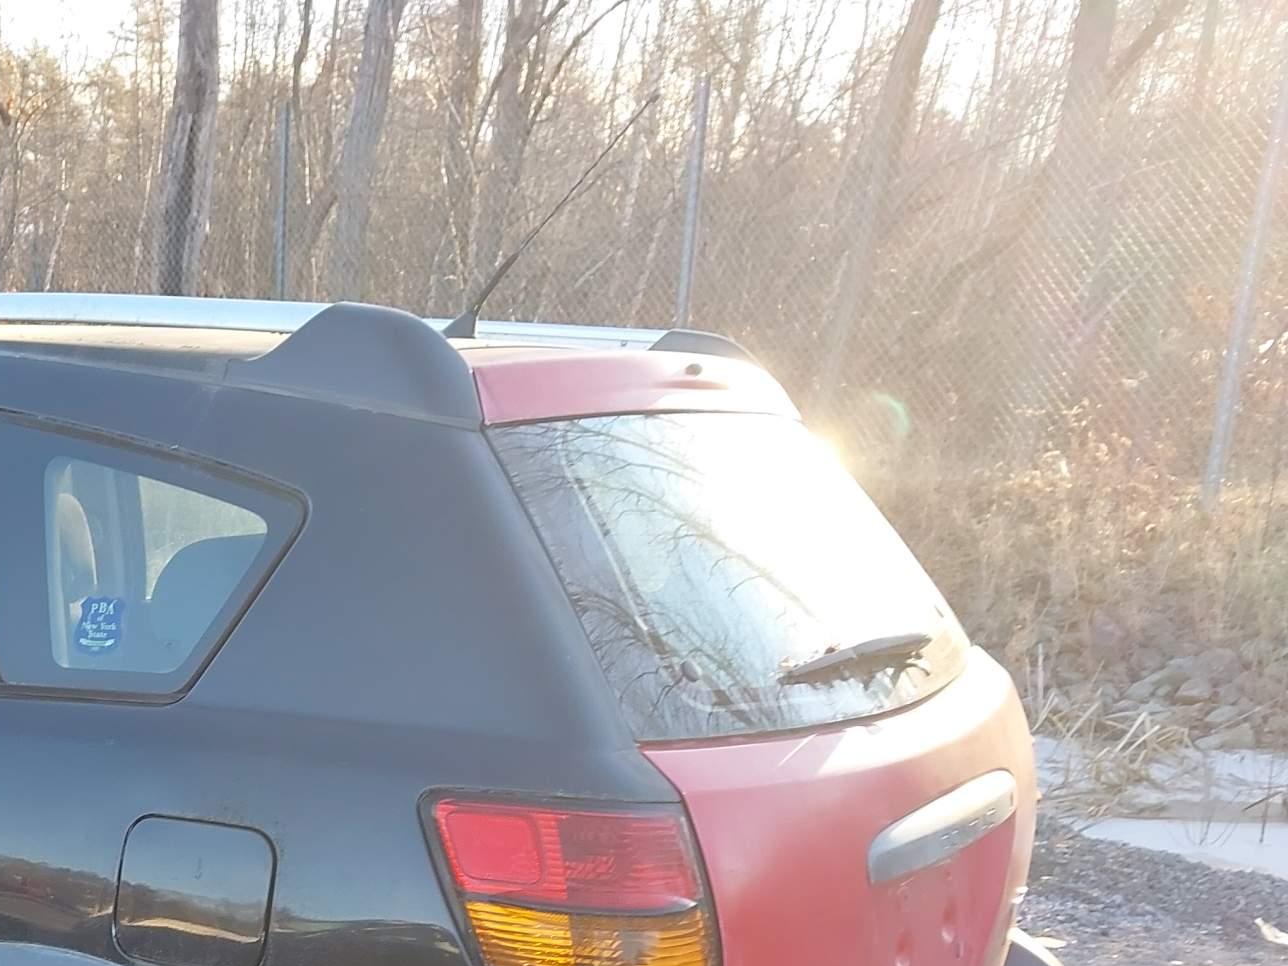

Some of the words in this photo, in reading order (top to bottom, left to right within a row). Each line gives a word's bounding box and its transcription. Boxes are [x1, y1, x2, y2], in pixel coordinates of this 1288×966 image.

[89, 600, 118, 615] PBA
[82, 622, 98, 631] New
[100, 622, 117, 631] York
[87, 630, 108, 639] State
